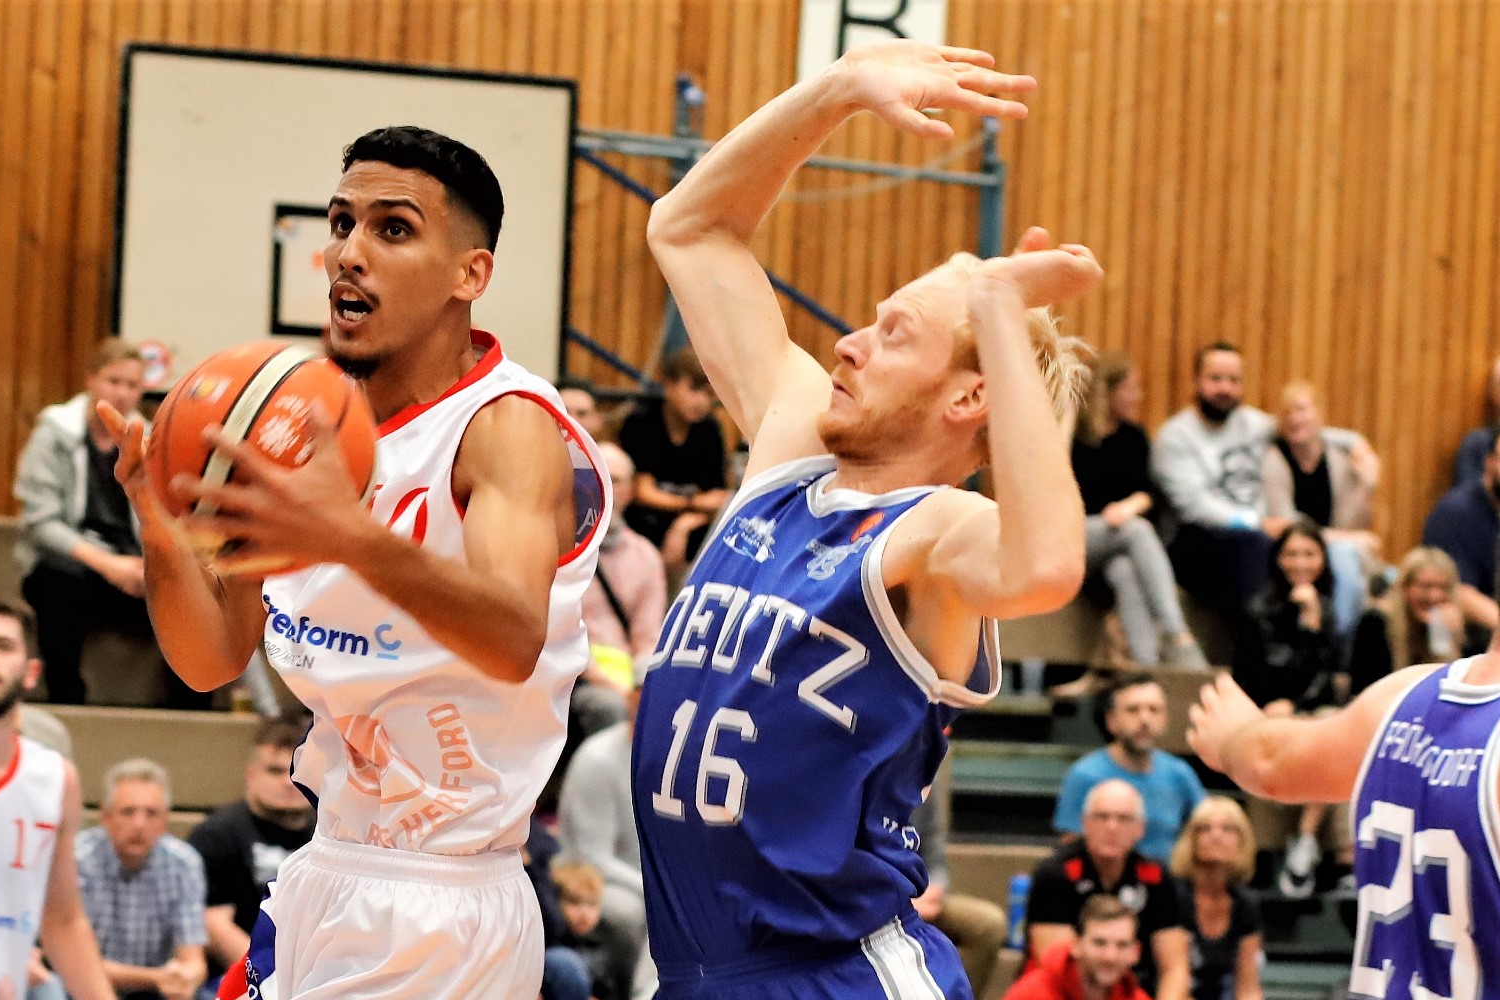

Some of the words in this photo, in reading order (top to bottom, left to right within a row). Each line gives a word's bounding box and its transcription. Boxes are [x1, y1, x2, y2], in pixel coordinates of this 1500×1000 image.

[647, 582, 870, 734] DEUTZ
[652, 699, 757, 826] 16
[9, 817, 57, 871] 17
